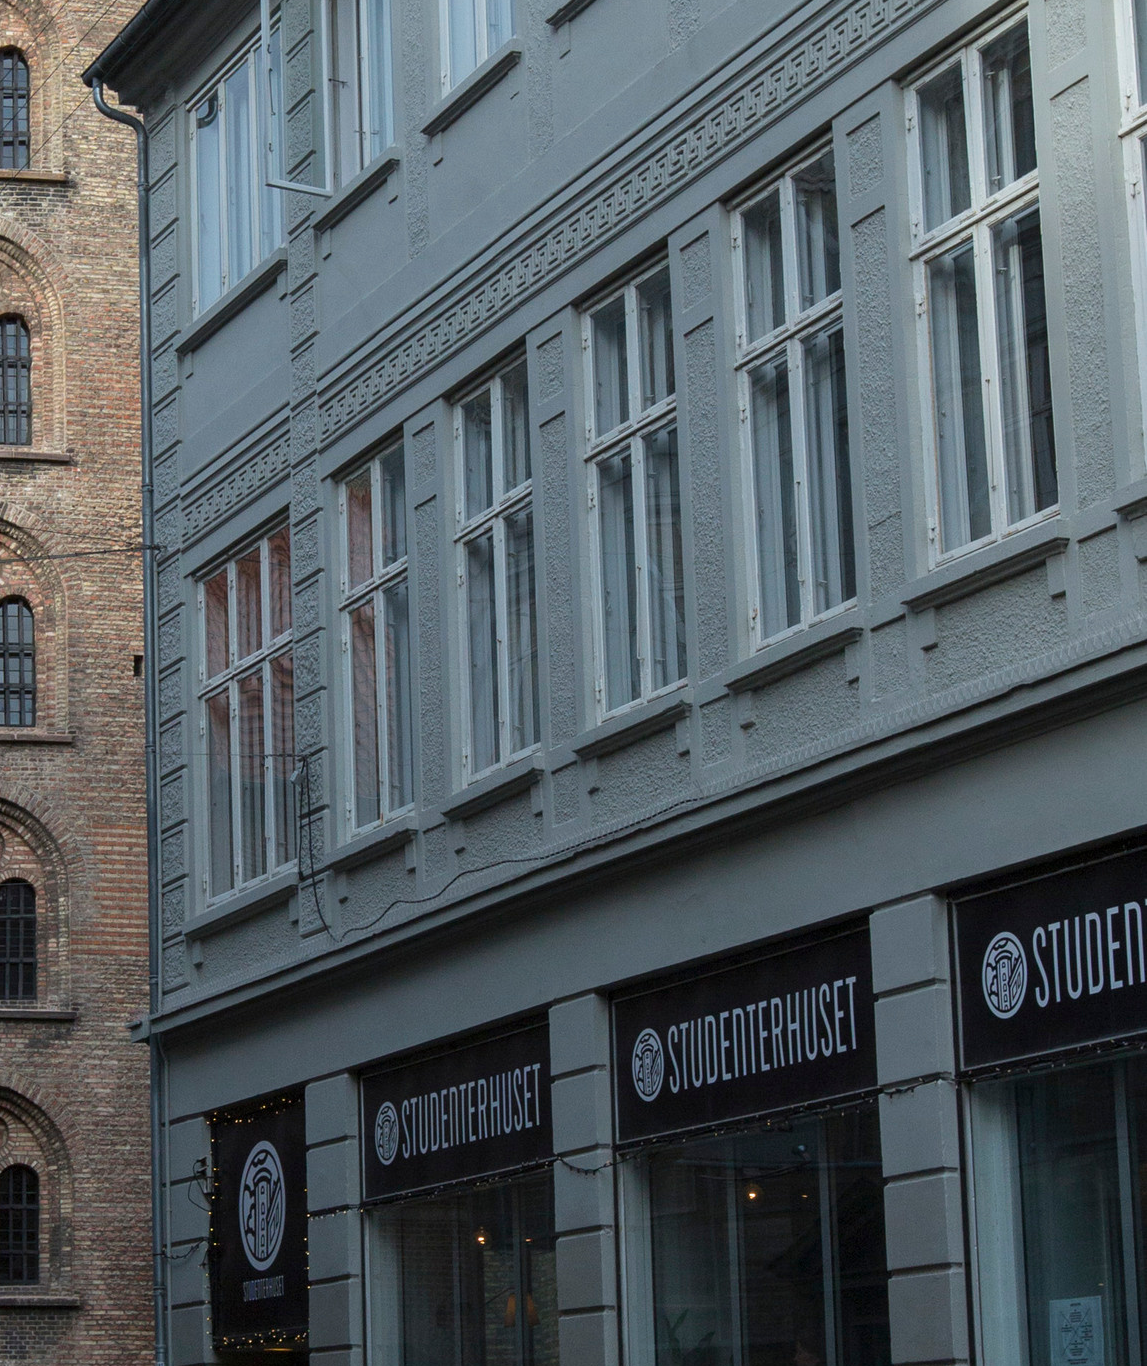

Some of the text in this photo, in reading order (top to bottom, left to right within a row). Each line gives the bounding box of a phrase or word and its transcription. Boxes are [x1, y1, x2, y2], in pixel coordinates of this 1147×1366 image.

[1032, 901, 1147, 1008] STUDEN
[667, 975, 858, 1093] STUDENTERHUSET
[400, 1063, 541, 1160] STUDENTERHUSET
